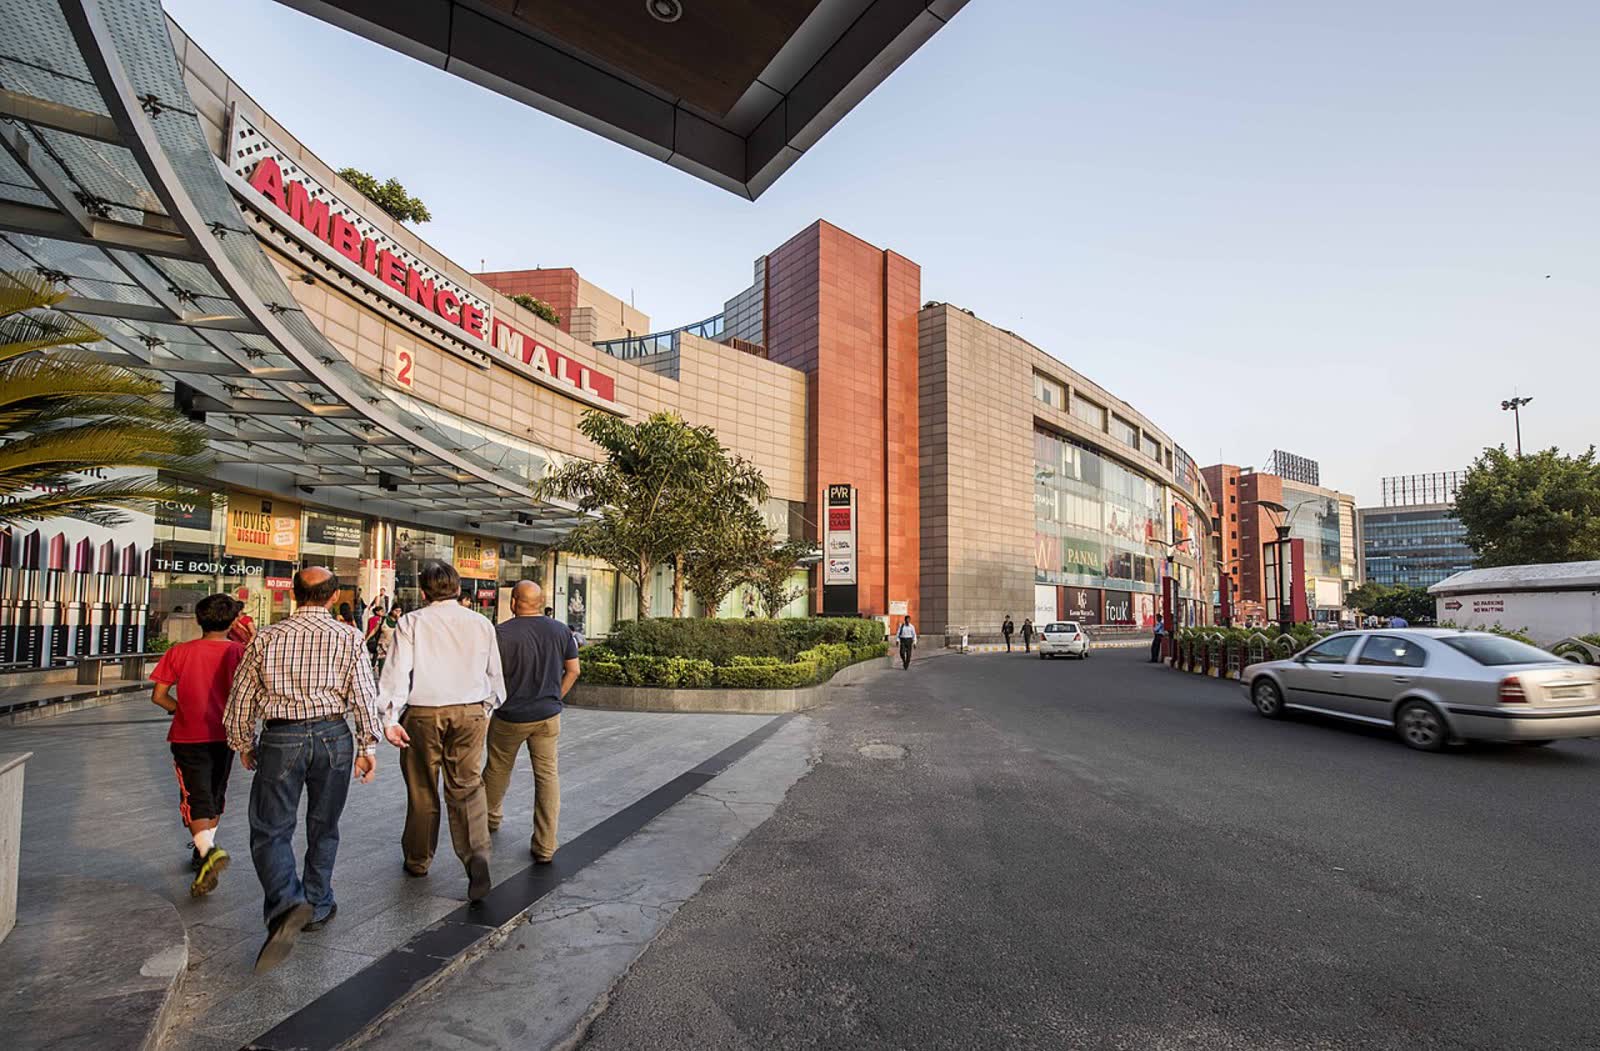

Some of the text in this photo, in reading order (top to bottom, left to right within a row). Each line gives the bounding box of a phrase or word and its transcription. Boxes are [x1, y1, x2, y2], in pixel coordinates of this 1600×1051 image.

[247, 156, 600, 397] AMBIENCE MALL
[398, 351, 412, 386] 2
[831, 487, 849, 499] PVR
[233, 510, 271, 532] MOVIES
[1035, 539, 1052, 569] W
[1068, 549, 1098, 567] PANNA
[156, 559, 264, 576] THE BODY SHOP
[1106, 600, 1127, 621] fcuk
